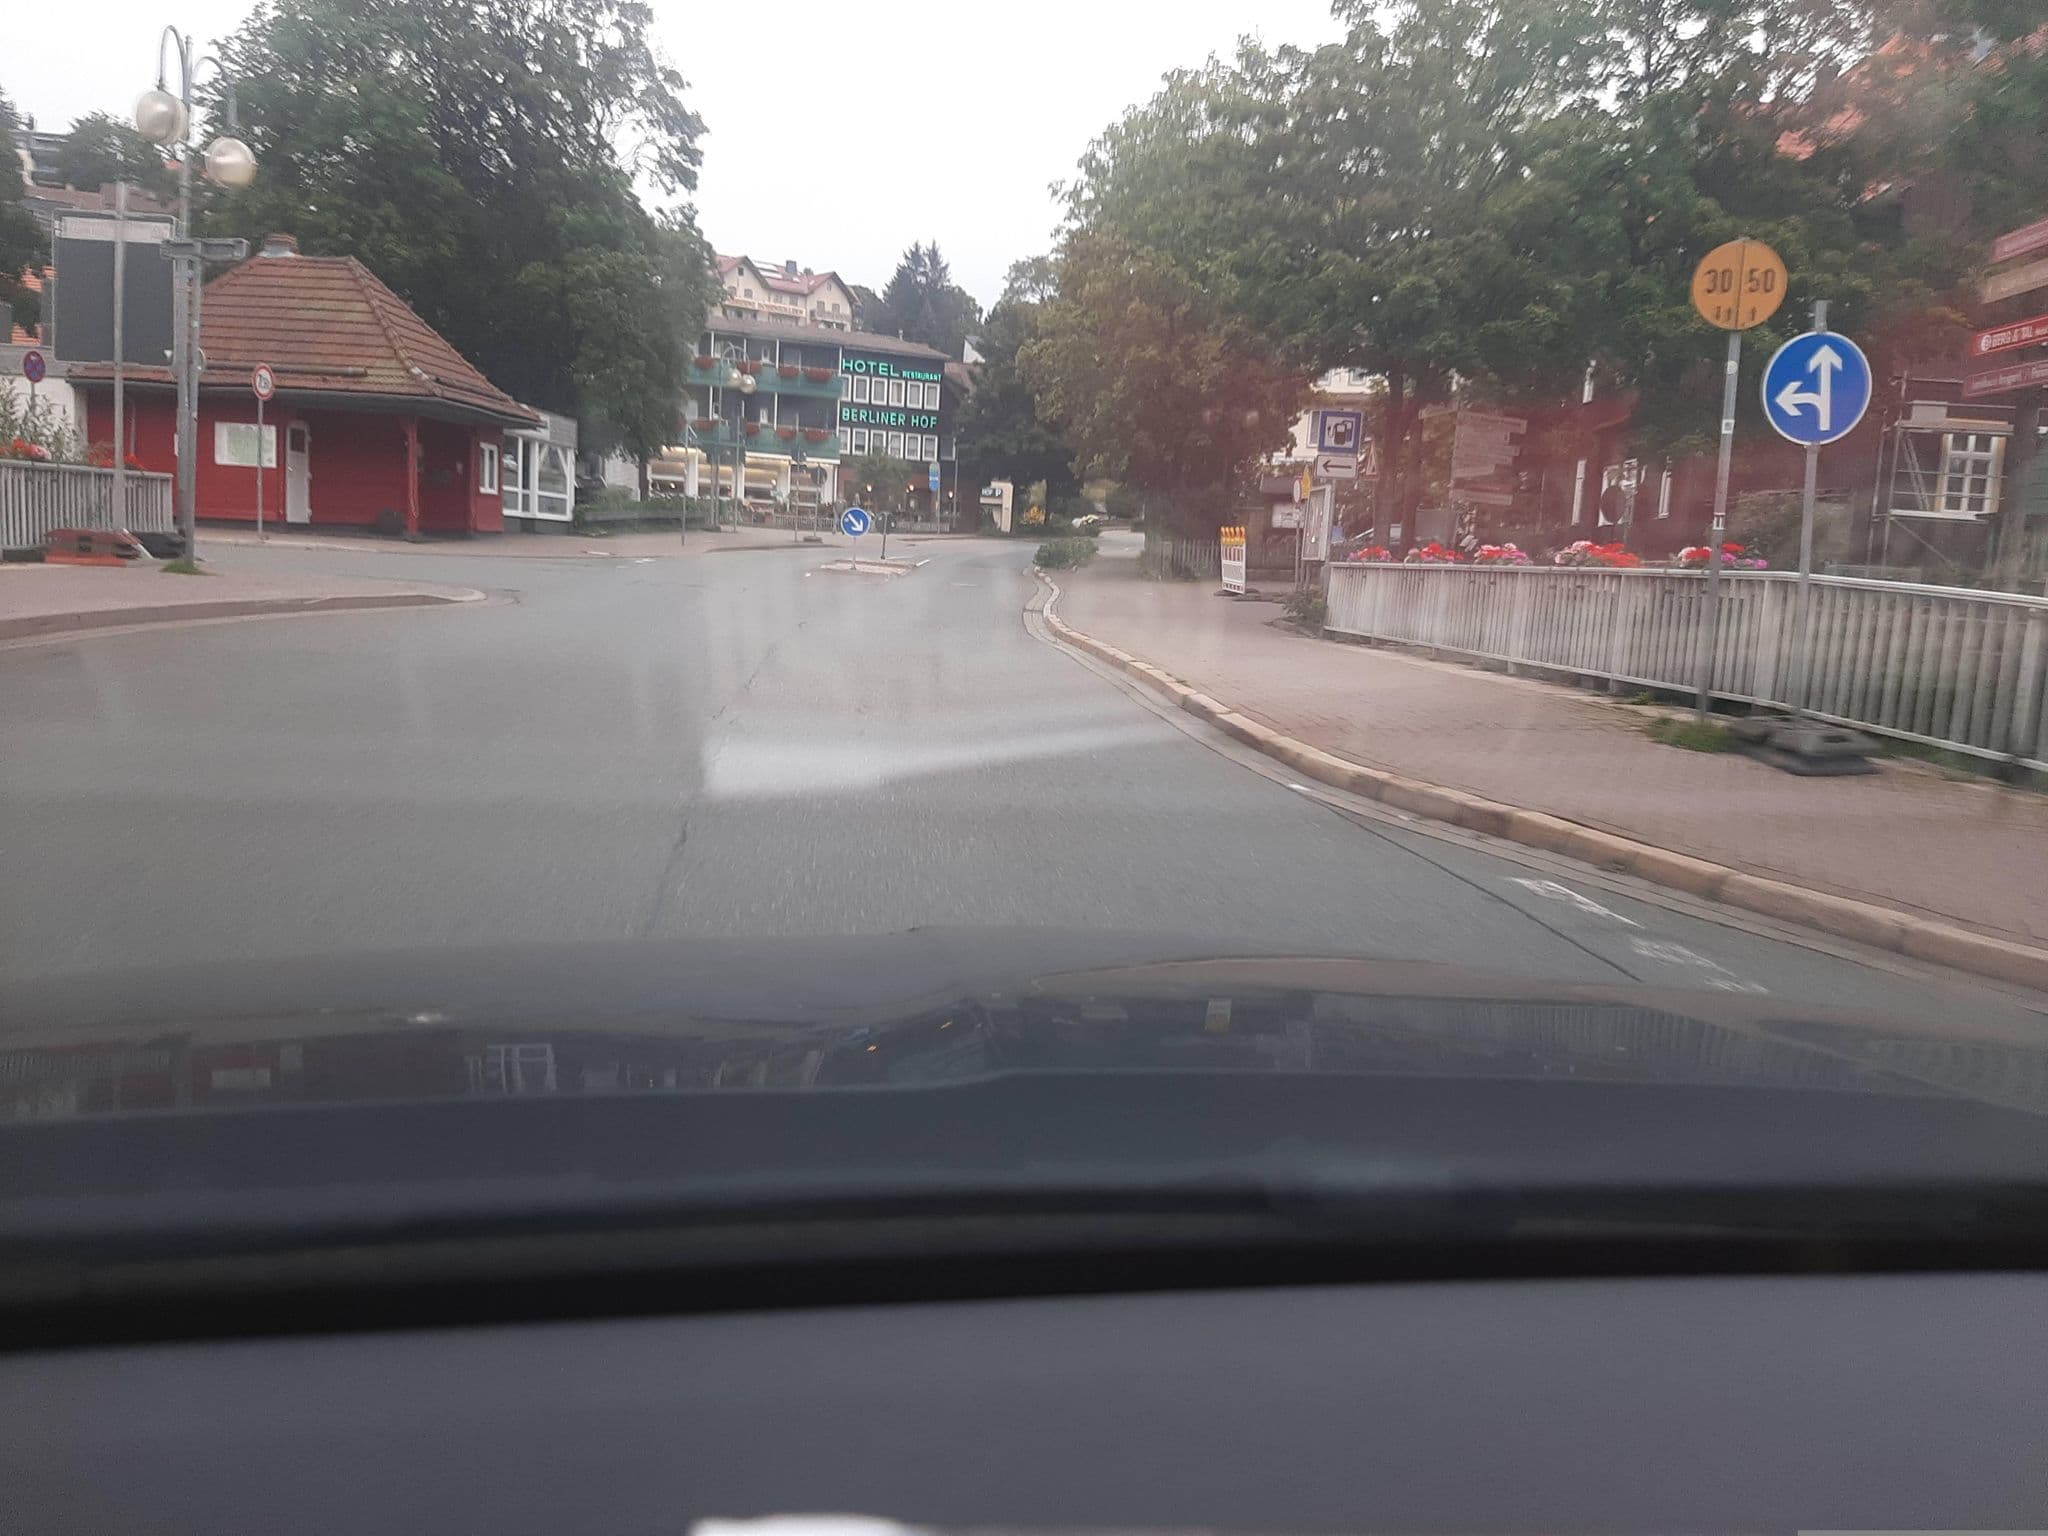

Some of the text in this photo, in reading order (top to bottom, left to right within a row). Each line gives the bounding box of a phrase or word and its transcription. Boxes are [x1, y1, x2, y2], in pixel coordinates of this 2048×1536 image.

[1704, 269, 1733, 294] 30
[1748, 268, 1776, 293] 50
[842, 358, 899, 377] HOTEL
[842, 407, 938, 429] BERLINER HOF
